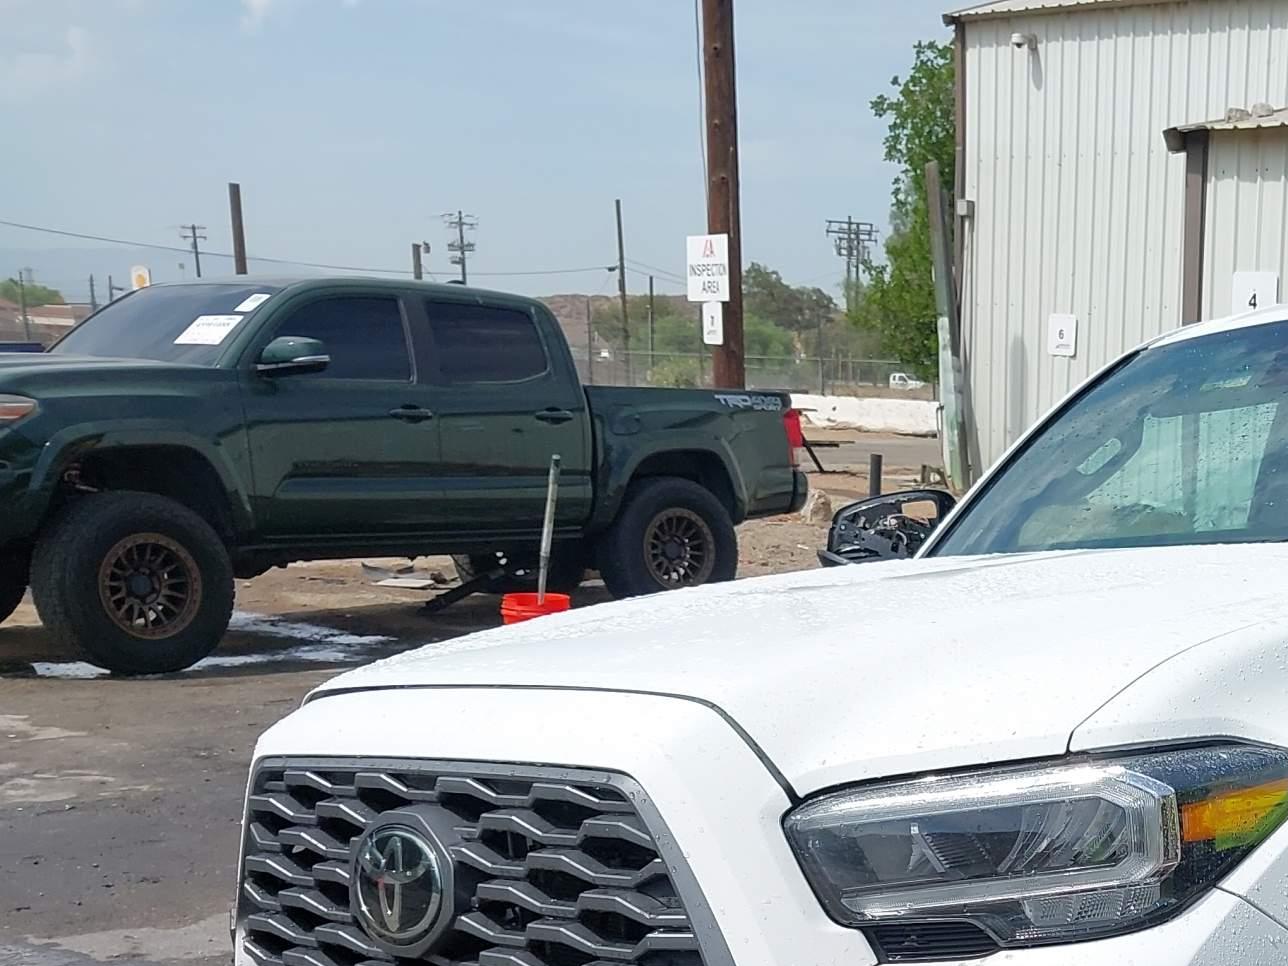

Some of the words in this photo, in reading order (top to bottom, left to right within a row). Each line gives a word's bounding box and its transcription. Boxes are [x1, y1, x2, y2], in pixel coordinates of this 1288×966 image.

[701, 280, 720, 294] AREA
[1248, 293, 1257, 309] 4
[1058, 329, 1065, 340] 6
[714, 394, 753, 408] TRD
